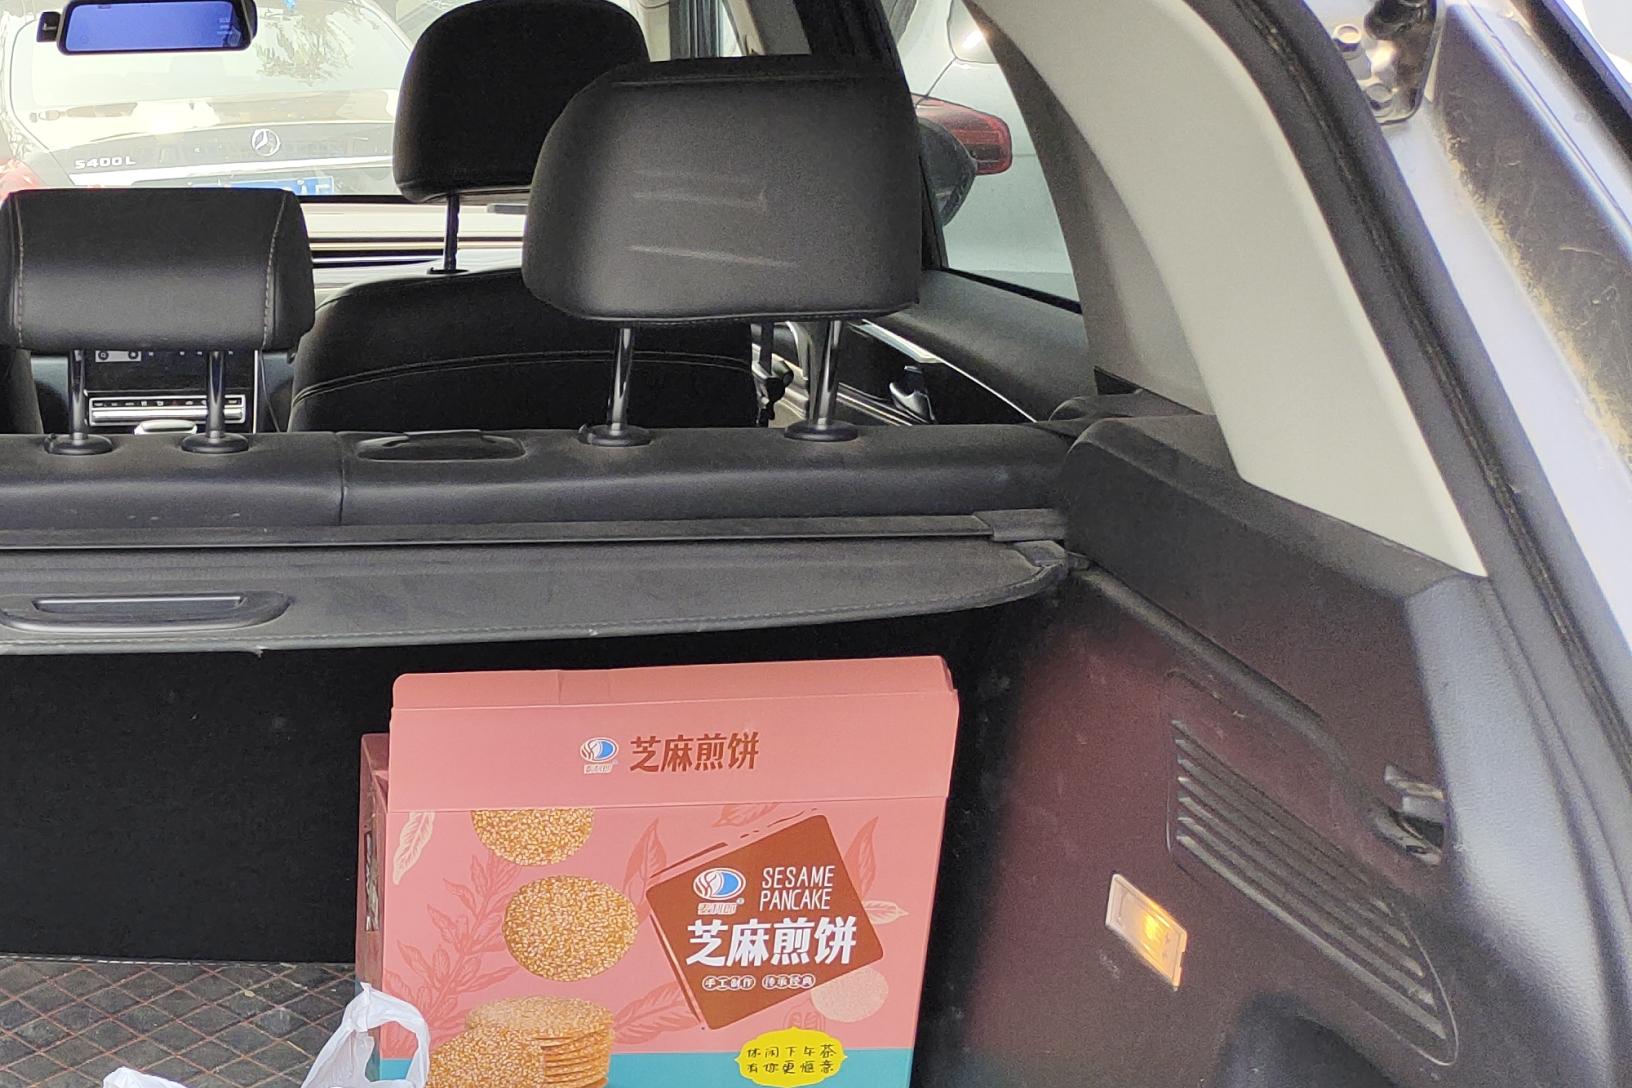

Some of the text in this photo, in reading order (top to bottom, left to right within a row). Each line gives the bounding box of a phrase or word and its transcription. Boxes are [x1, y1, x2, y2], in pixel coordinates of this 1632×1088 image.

[630, 731, 760, 773] 芝麻煎饼
[762, 865, 835, 889] SESAME
[759, 888, 832, 912] PANCAKE
[686, 916, 857, 967] 芝麻煎饼
[747, 1044, 837, 1058] 休闲下午茶
